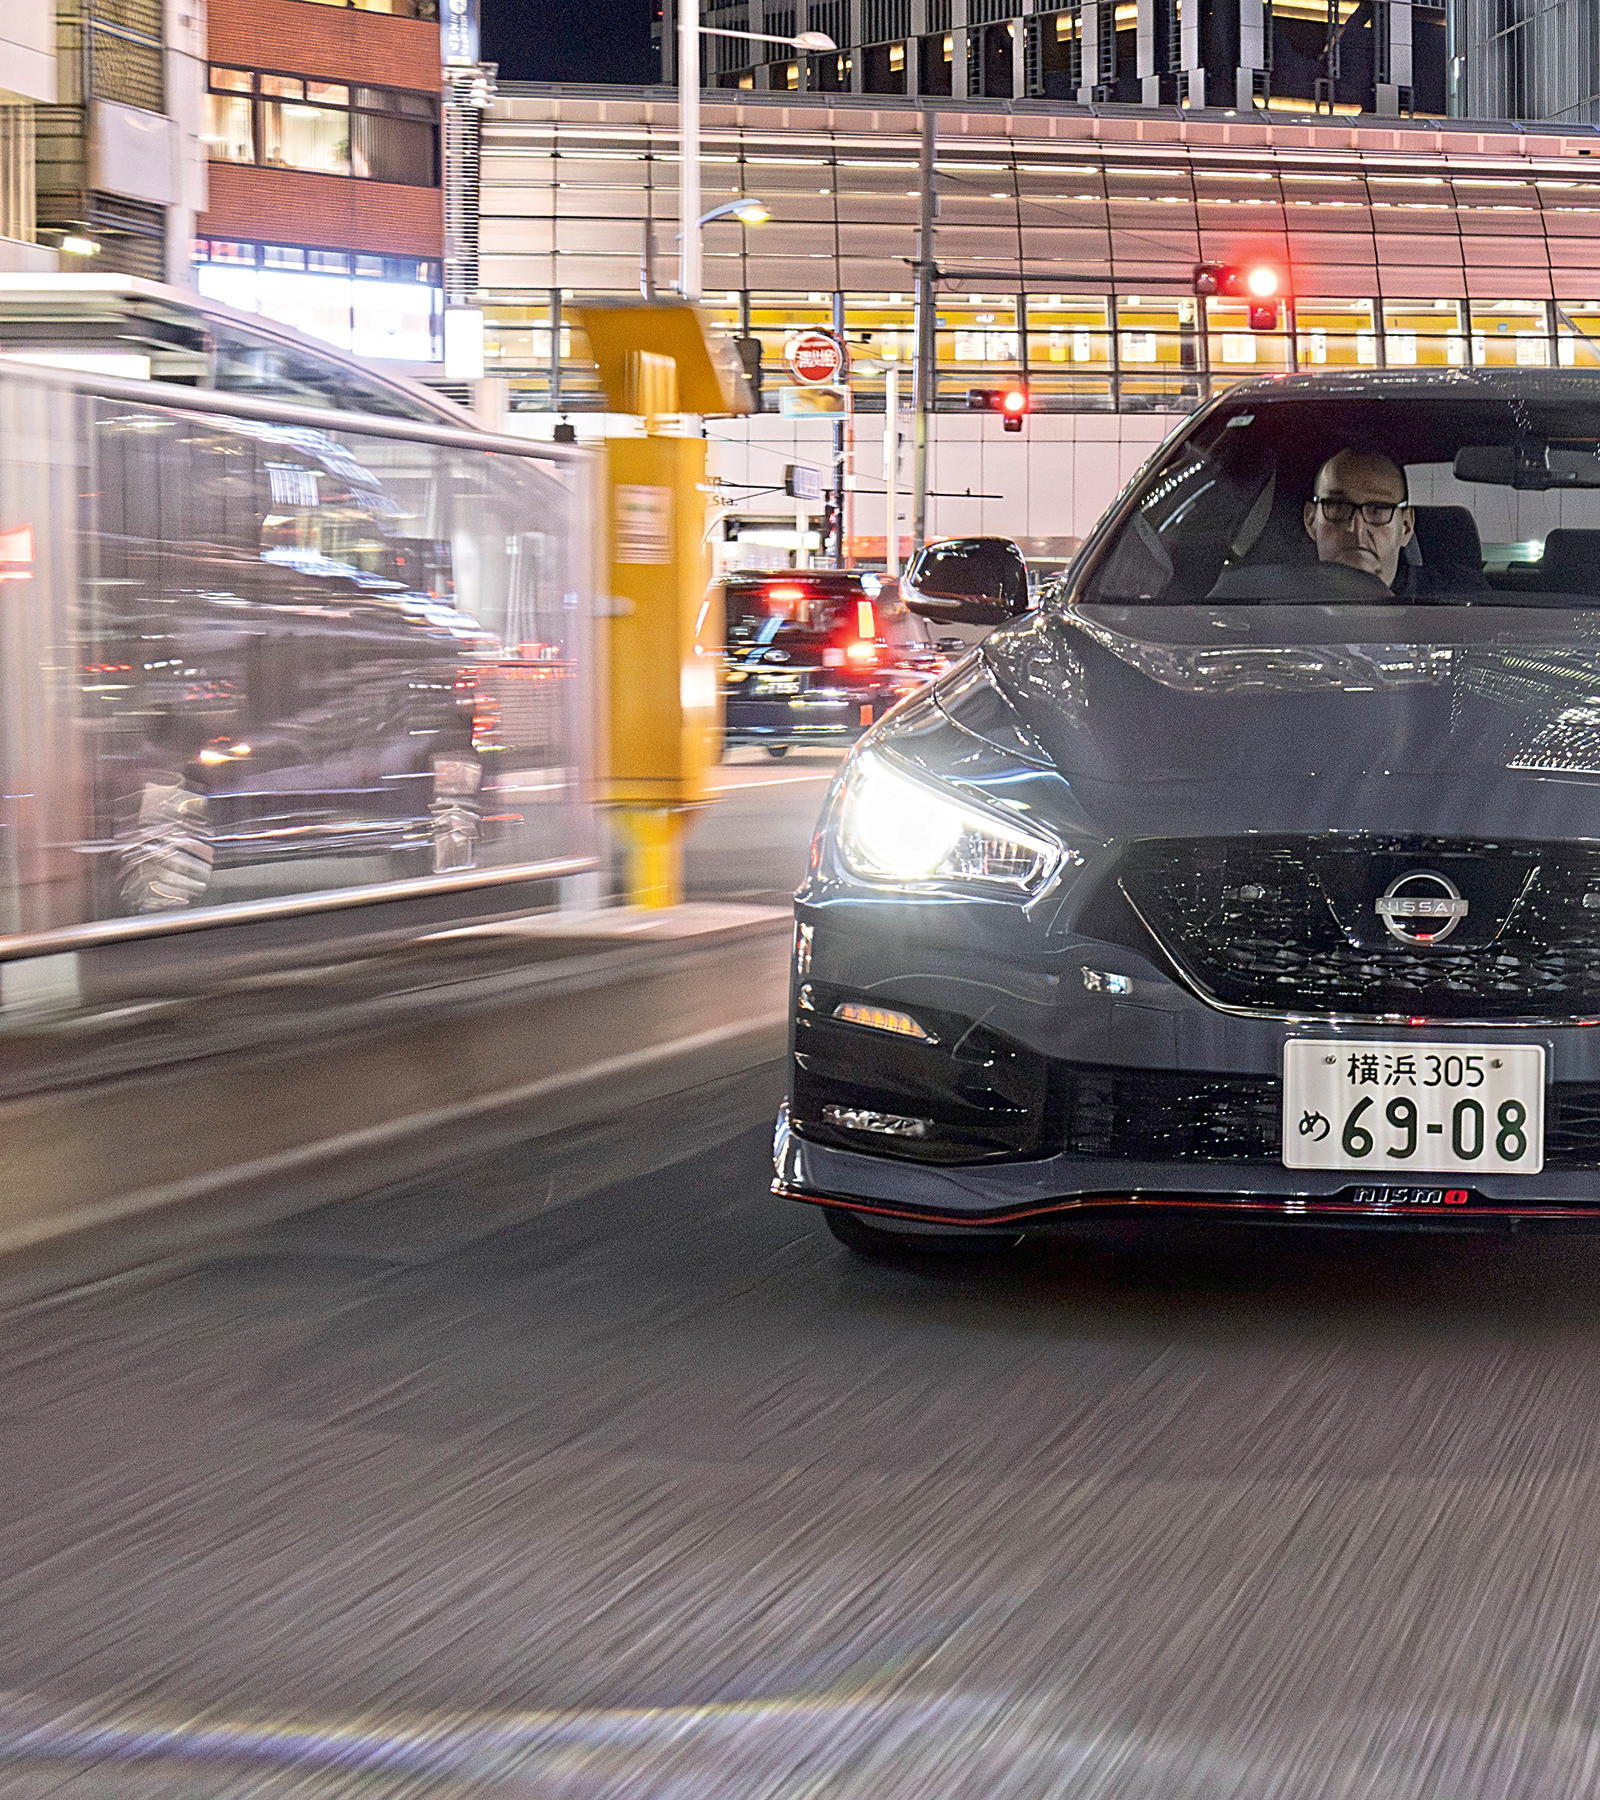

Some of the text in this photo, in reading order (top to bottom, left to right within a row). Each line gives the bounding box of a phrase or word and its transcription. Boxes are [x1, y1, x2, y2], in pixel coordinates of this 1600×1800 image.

[1378, 900, 1467, 913] NISSAN
[1299, 1095, 1527, 1162] め 69-08
